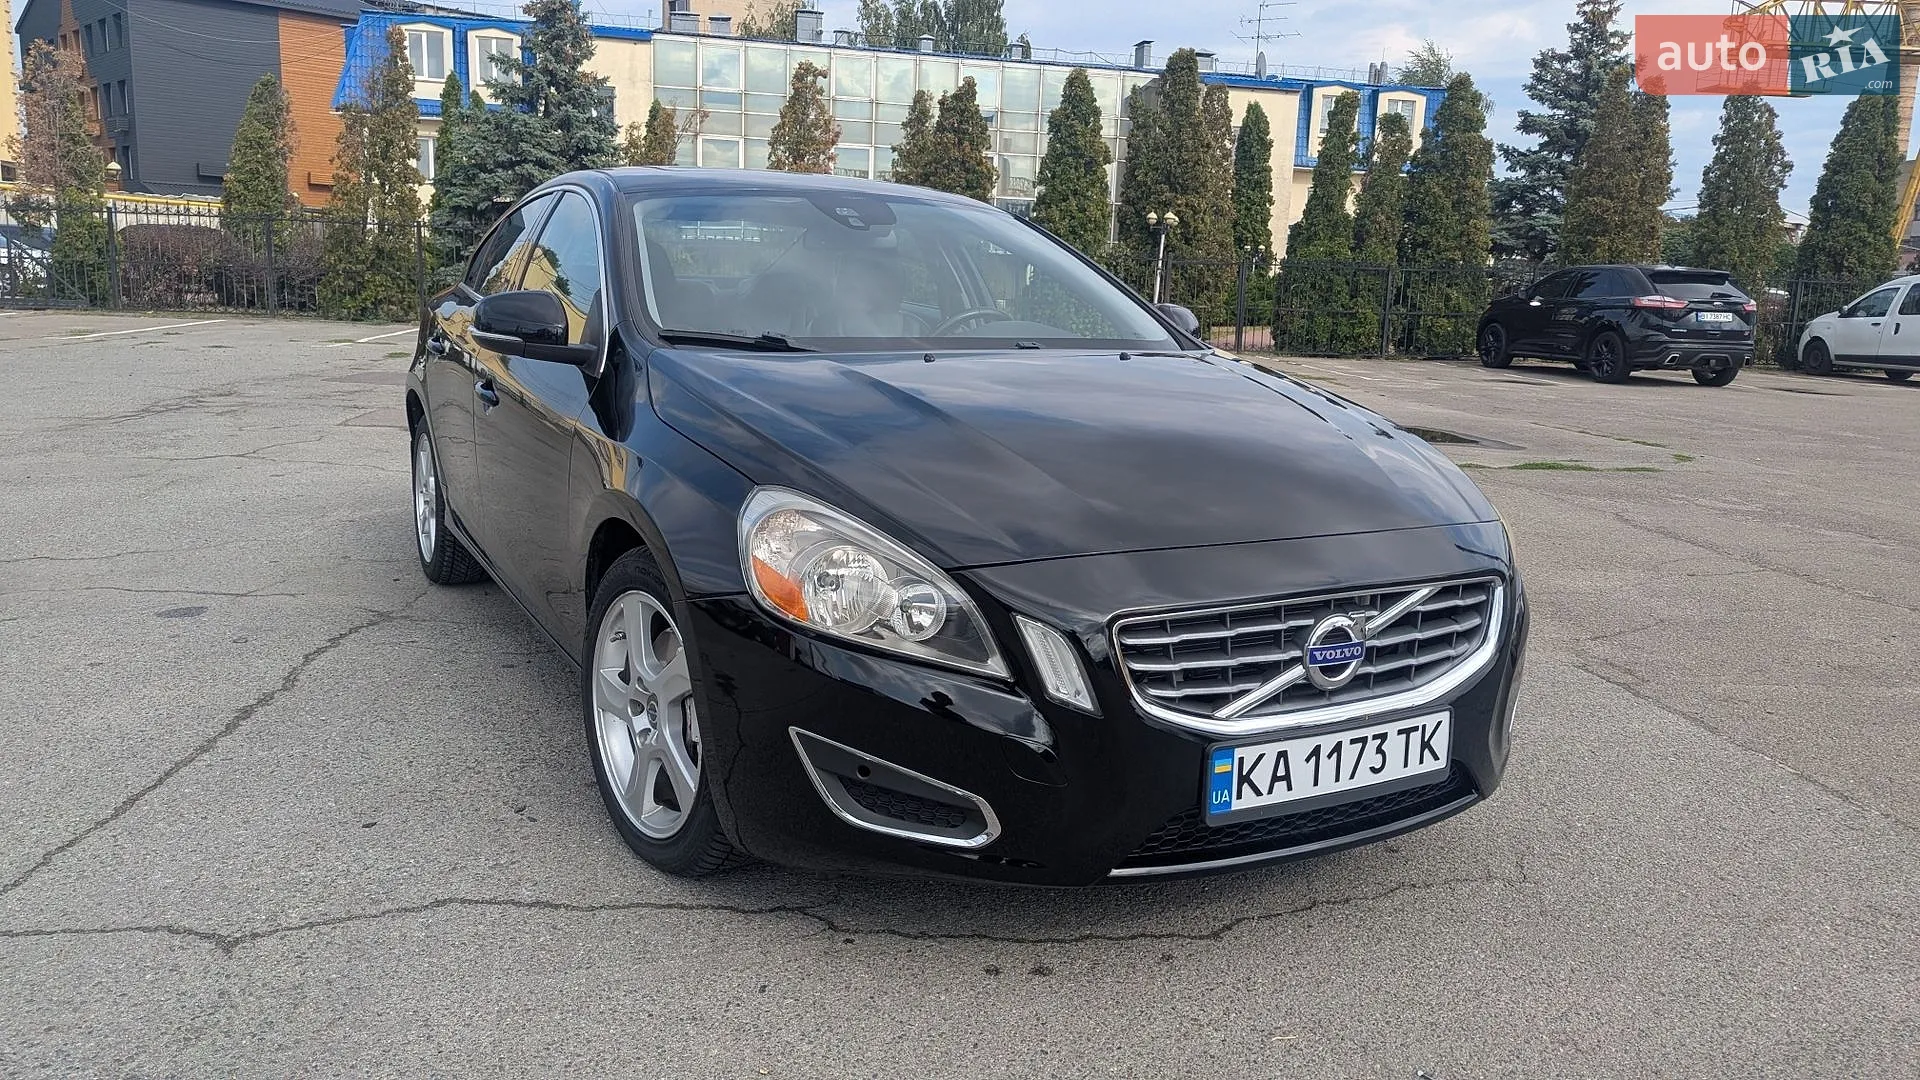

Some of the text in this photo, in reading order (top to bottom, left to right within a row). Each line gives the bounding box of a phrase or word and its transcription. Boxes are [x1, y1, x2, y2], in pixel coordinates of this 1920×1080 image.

[1313, 646, 1361, 661] VOLVO
[1235, 719, 1443, 800] KA 1173 TK
[1212, 789, 1230, 804] UA
